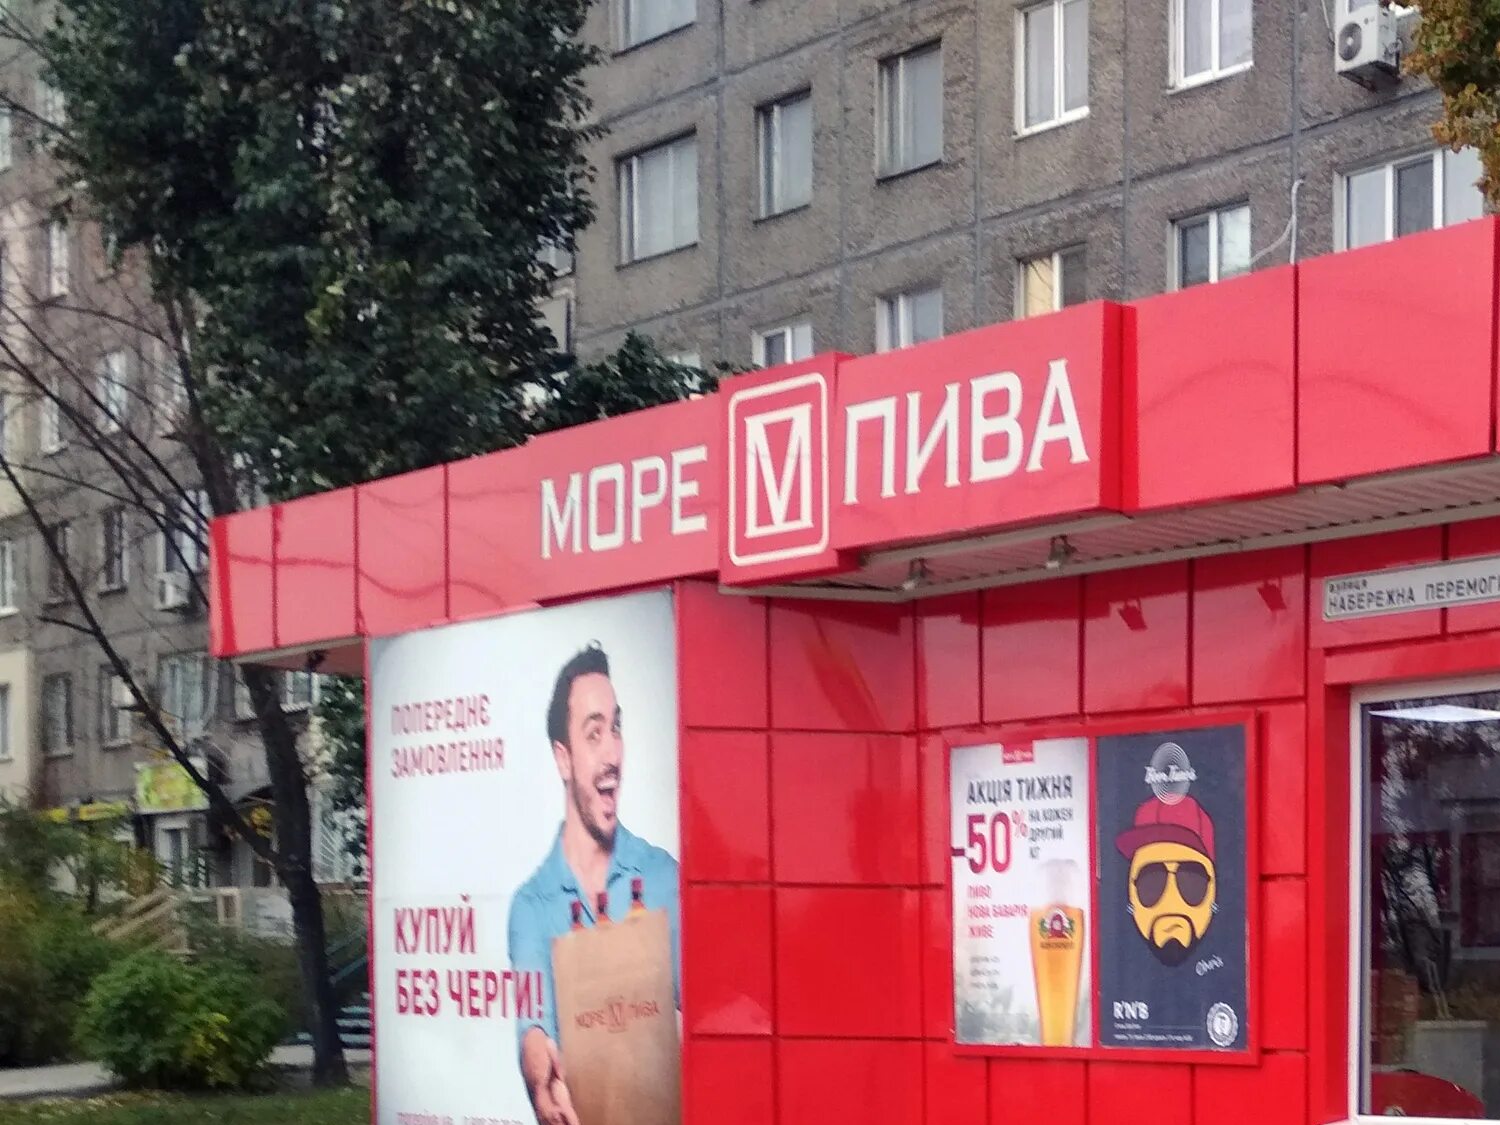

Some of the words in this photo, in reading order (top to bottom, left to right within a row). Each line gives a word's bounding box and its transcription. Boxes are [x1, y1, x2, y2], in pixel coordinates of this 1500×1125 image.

[540, 445, 708, 560] МОРЕ
[843, 358, 1090, 505] ПИВА
[1328, 585, 1416, 613] НАБЕРЕЖНА
[391, 737, 506, 779] ЗАМОВЛЕННЯ
[966, 779, 1012, 806] АКЦІЯ
[1015, 774, 1073, 802] ТИЖНЯ
[394, 894, 477, 955] КУПУЙ
[395, 968, 441, 1017] БЕЗ
[447, 969, 545, 1020] ЧЕРГИ!
